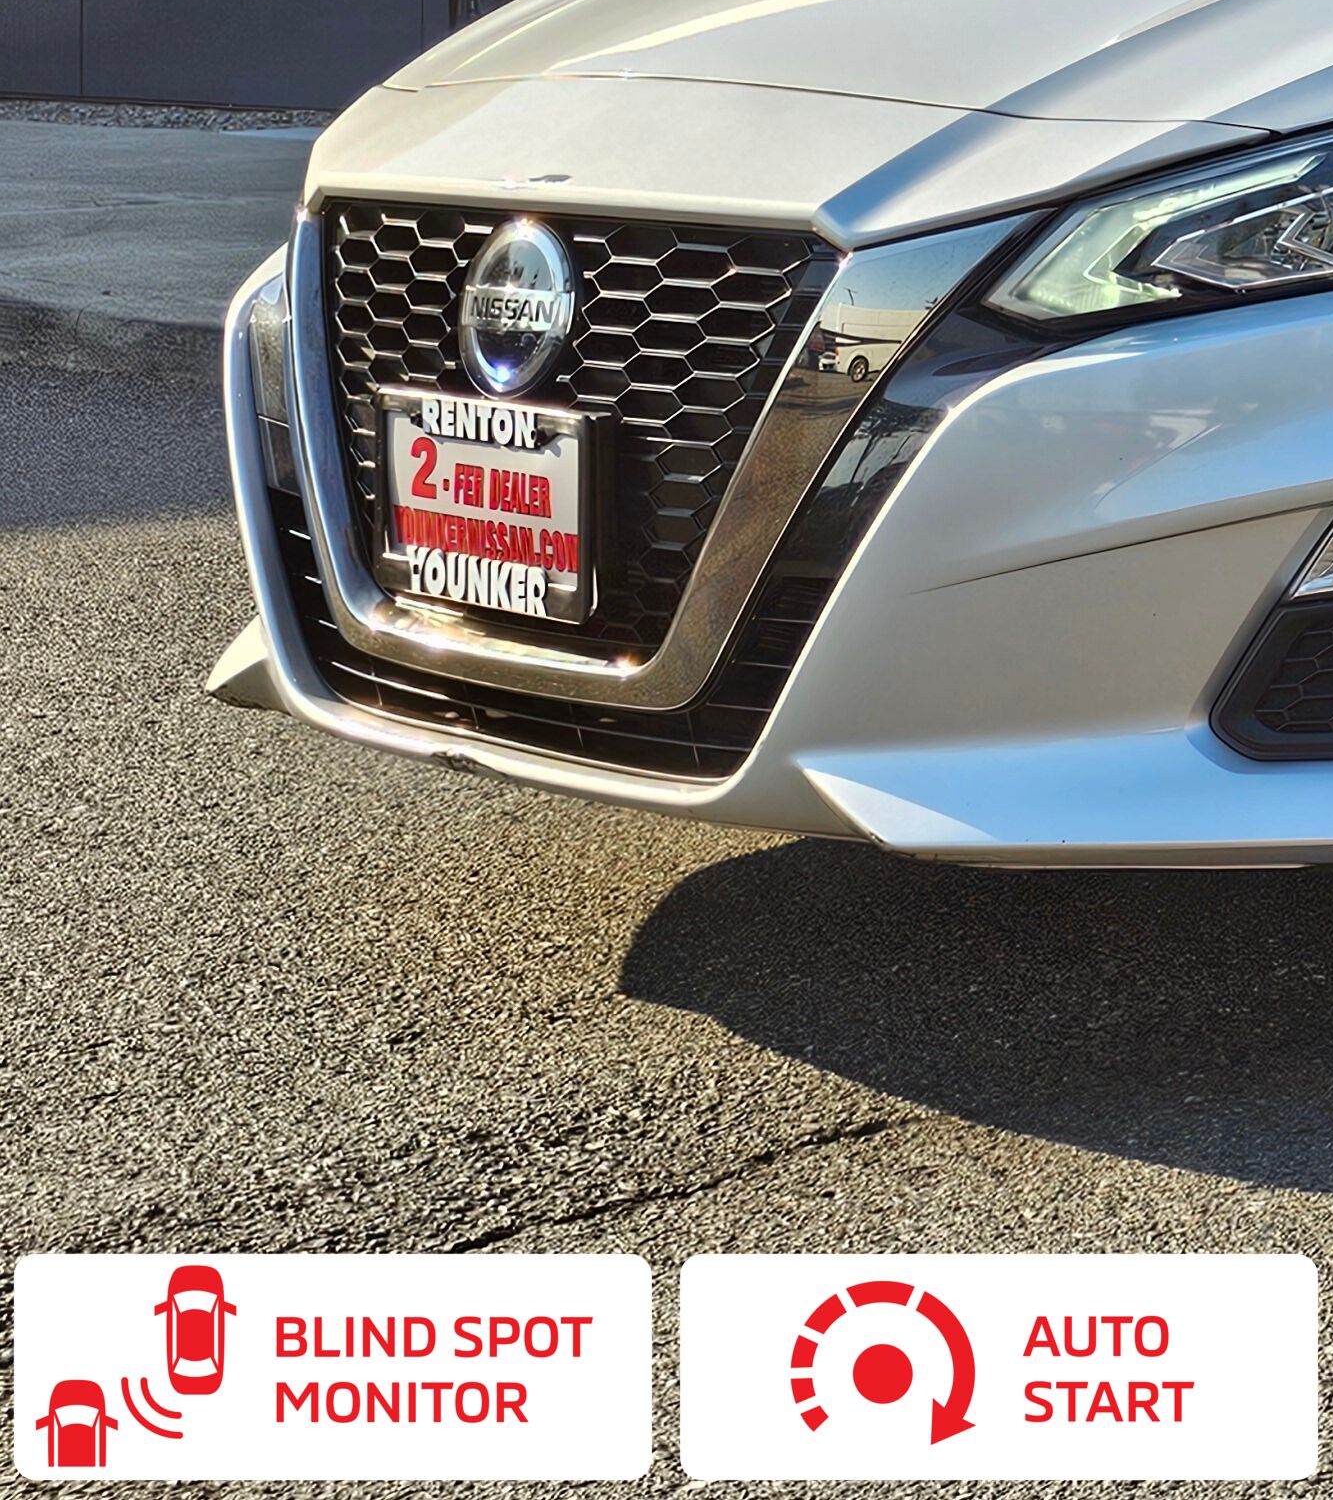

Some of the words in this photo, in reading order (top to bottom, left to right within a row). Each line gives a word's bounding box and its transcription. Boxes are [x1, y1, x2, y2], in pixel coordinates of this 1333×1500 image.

[471, 295, 555, 324] NISSAN
[421, 398, 537, 449] RENTON
[489, 468, 552, 519] DEALER
[405, 544, 547, 617] YOUNKER
